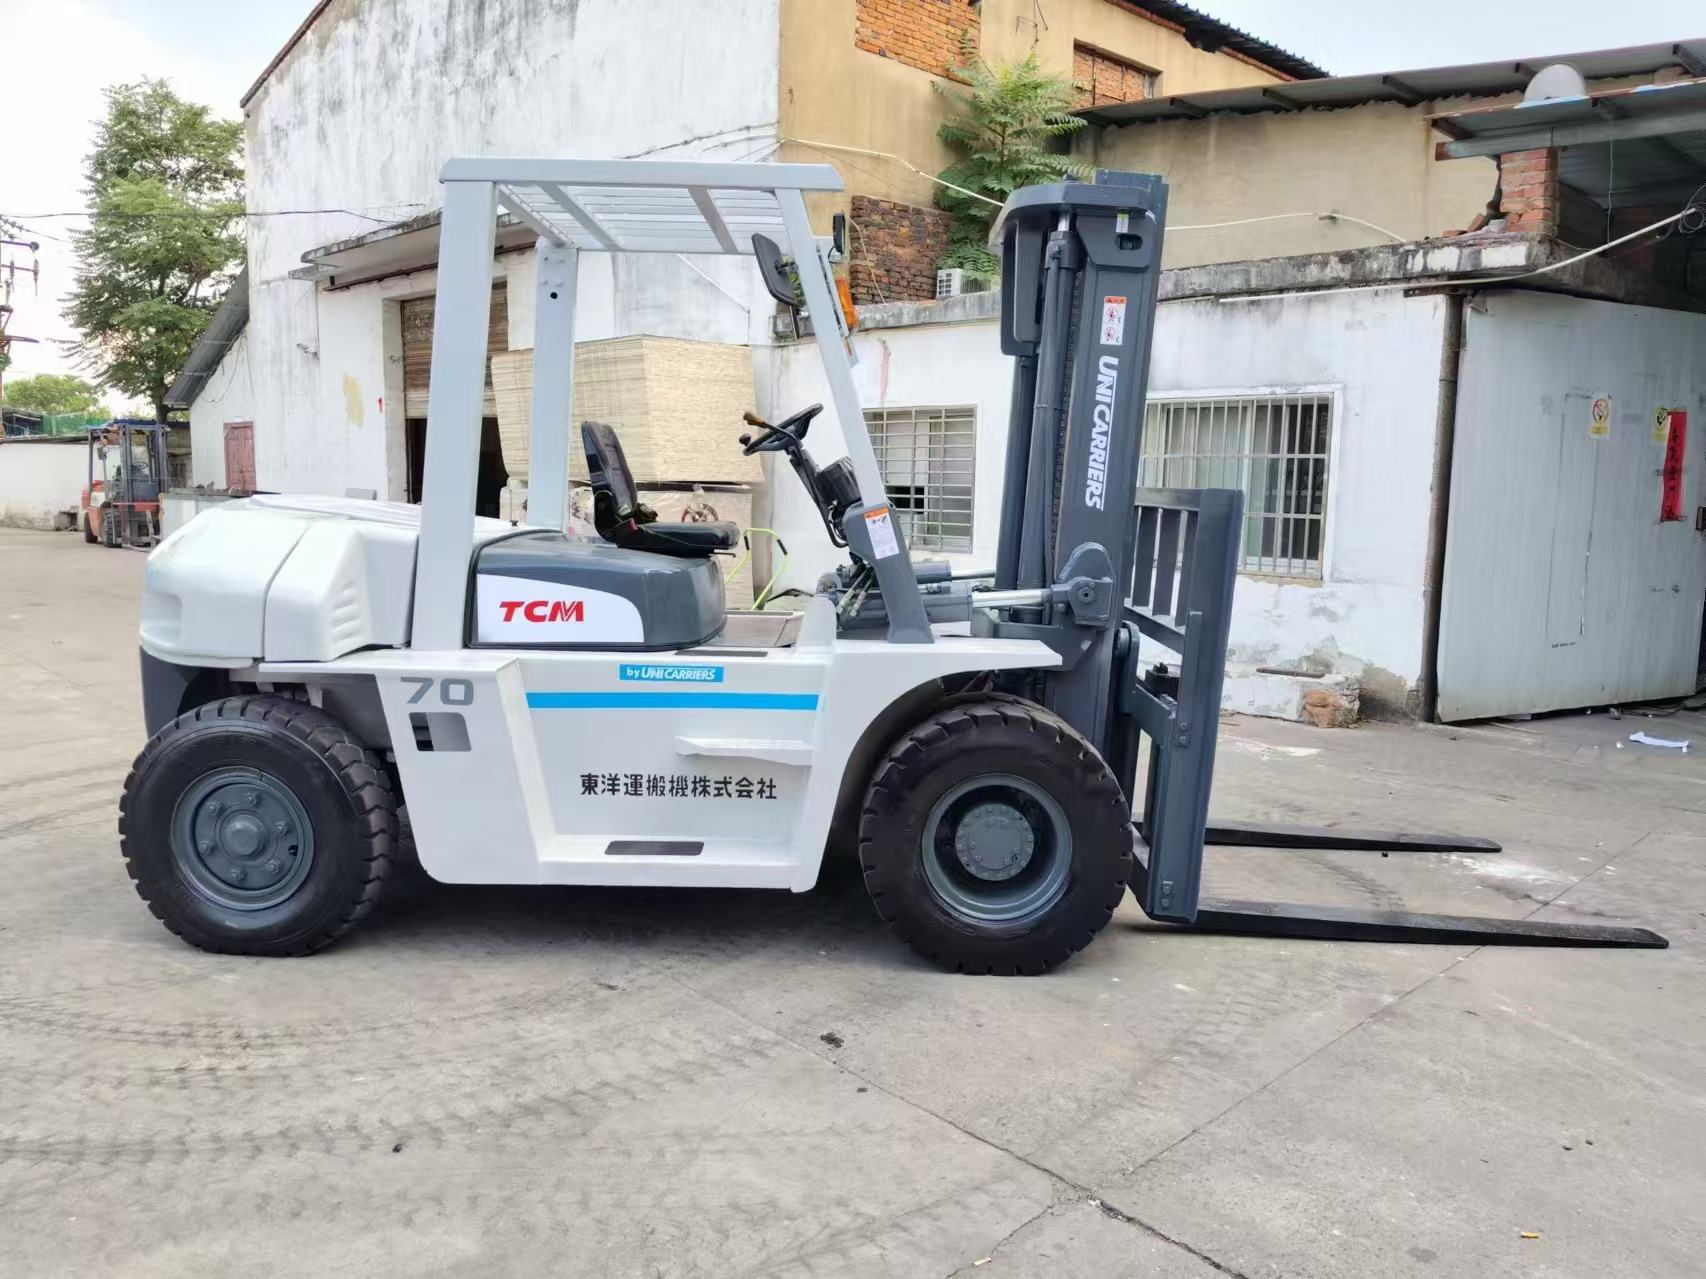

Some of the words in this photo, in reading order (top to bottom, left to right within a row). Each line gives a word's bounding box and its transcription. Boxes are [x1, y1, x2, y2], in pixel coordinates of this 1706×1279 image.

[1085, 355, 1119, 511] UNICARRIERS
[499, 600, 584, 623] TCM
[626, 667, 640, 679] by
[641, 666, 716, 680] UNICARRIERS
[400, 676, 474, 706] 70
[580, 772, 777, 799] 東洋運搬機株式会社
